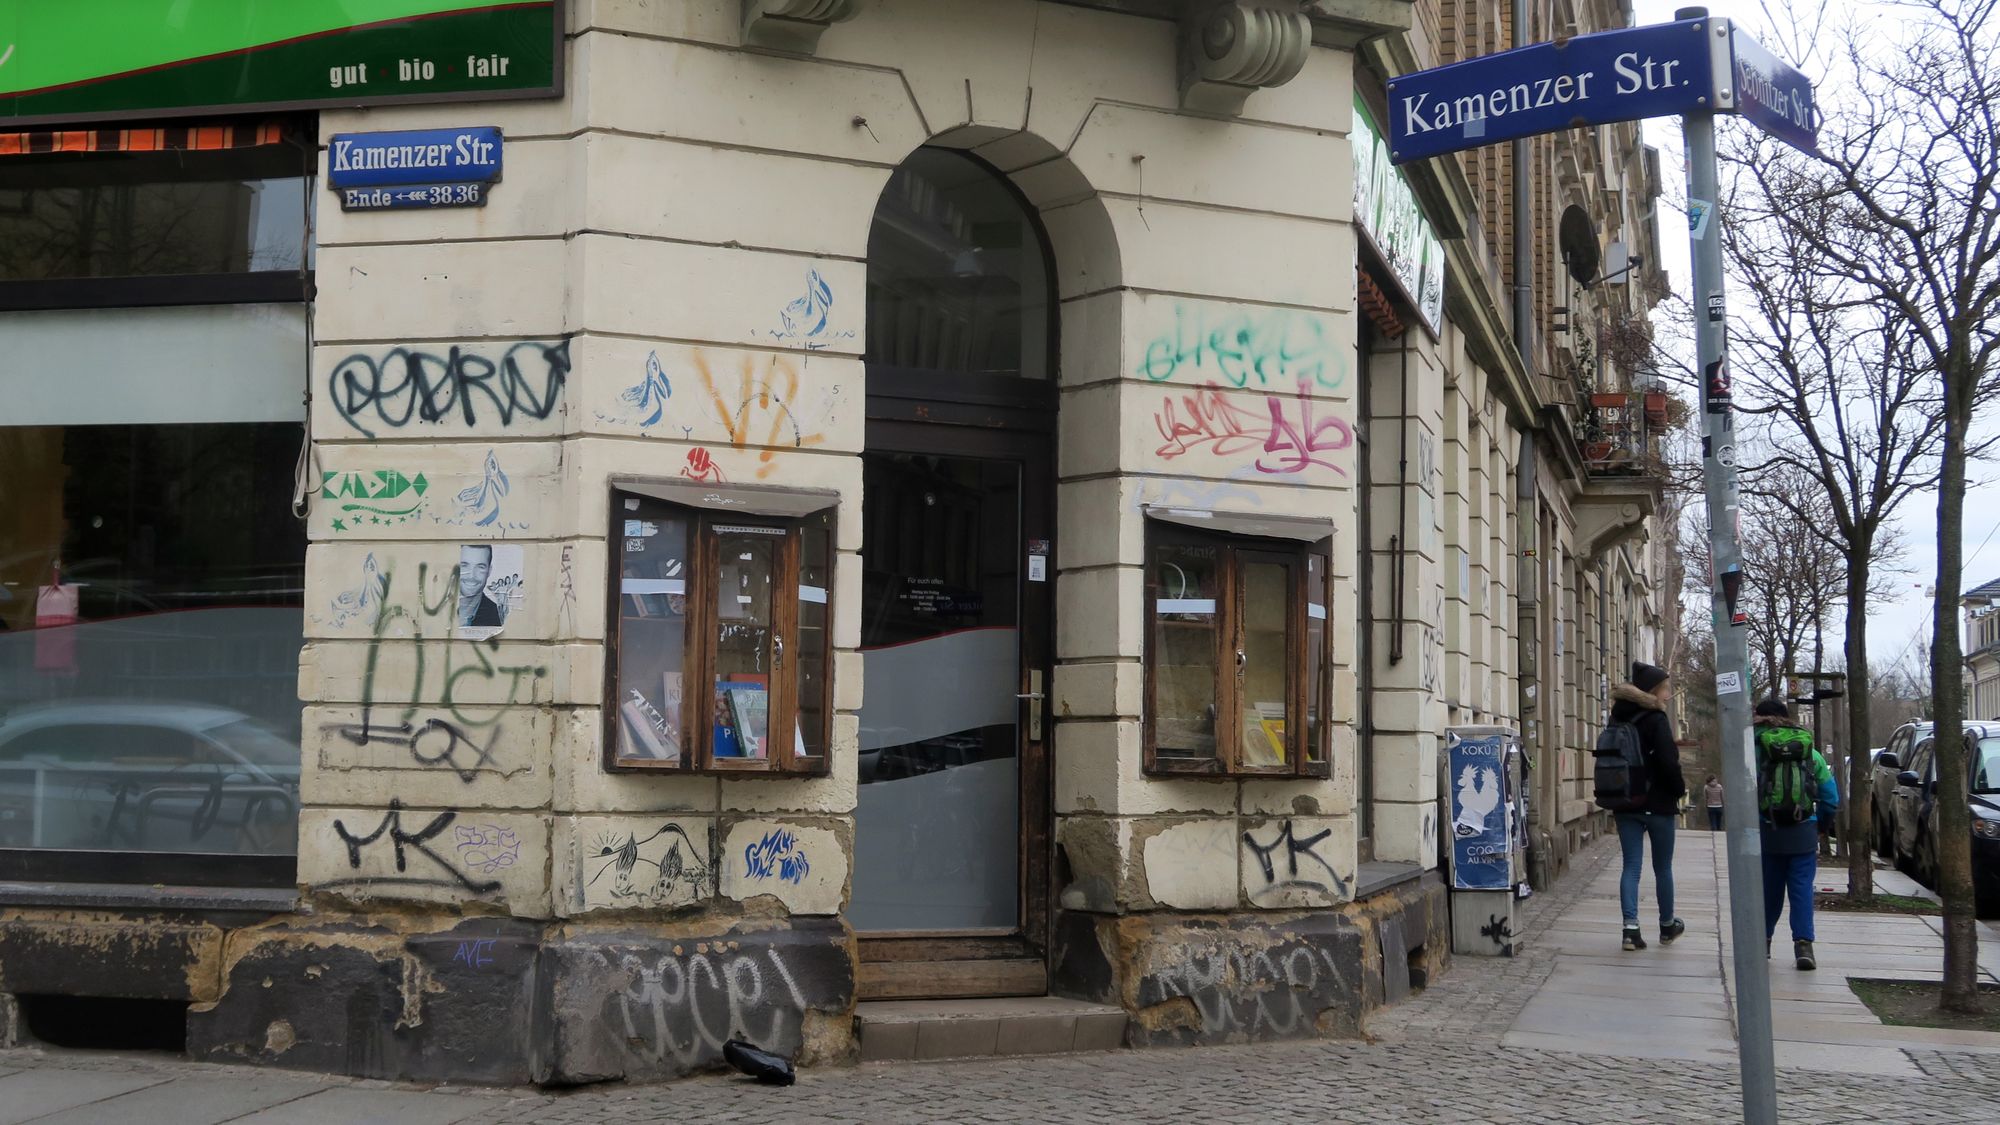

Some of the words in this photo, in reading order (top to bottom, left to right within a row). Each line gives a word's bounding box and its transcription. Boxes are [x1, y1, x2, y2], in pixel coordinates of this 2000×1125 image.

[330, 63, 368, 88] gut
[399, 58, 435, 81] bio
[467, 54, 509, 78] fair
[1403, 70, 1594, 137] Kamenzer
[1613, 51, 1689, 96] Str.
[333, 140, 452, 171] Kamenzer
[455, 134, 495, 166] Str.
[345, 189, 392, 208] Ende
